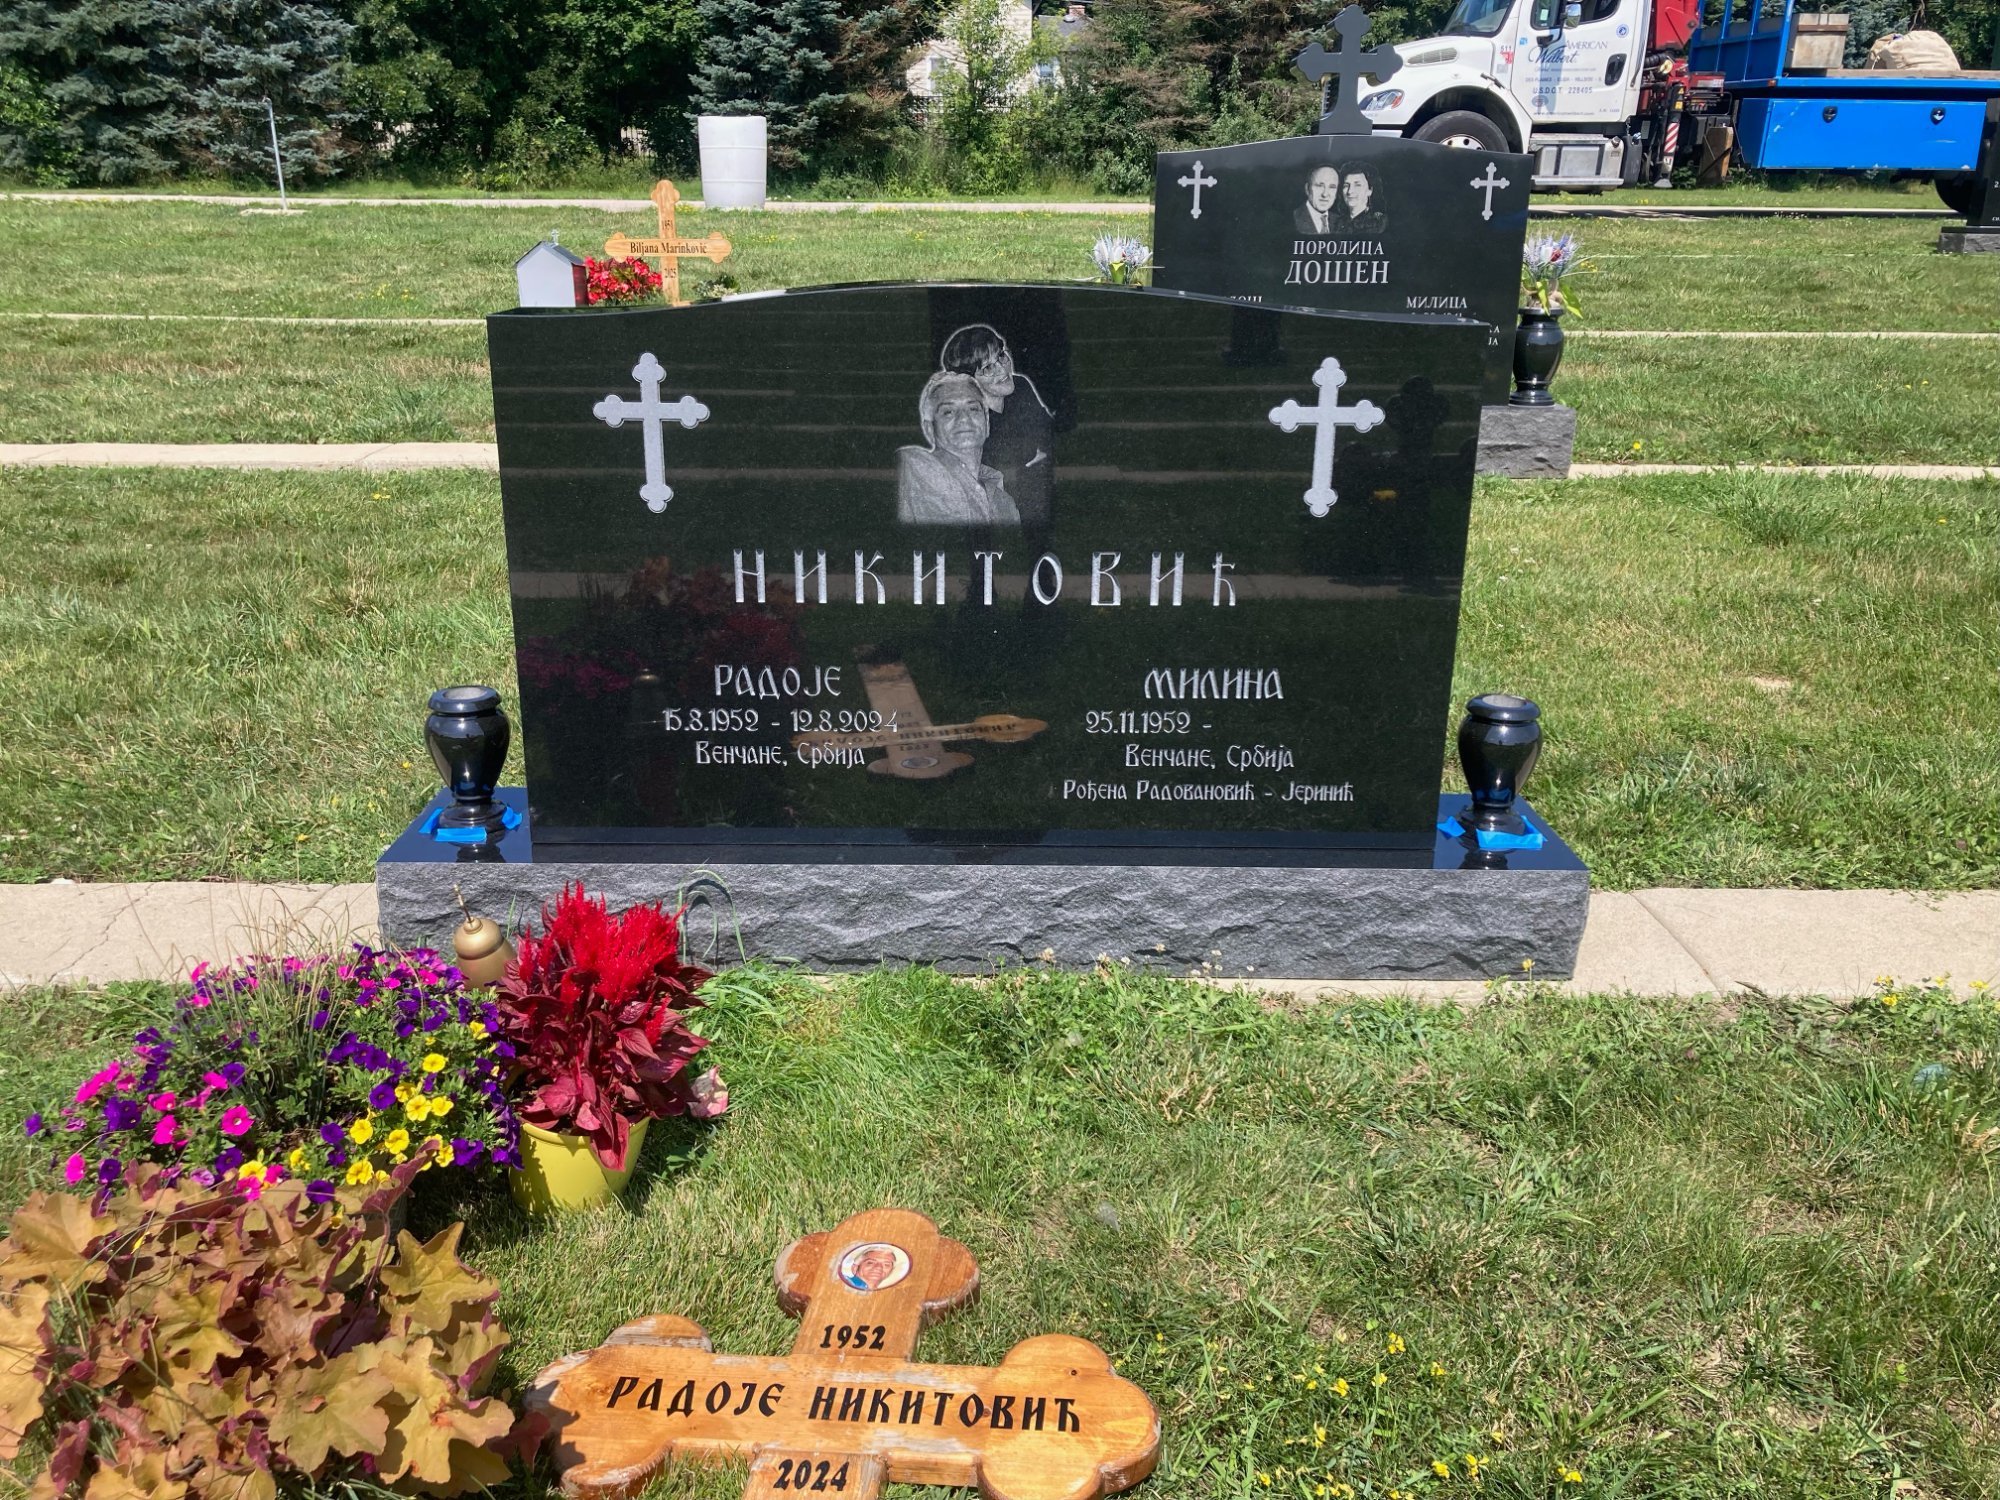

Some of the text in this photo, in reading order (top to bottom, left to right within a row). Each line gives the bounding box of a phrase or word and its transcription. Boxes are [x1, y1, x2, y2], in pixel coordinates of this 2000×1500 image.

[630, 242, 707, 255] Biljana Marinković
[1293, 240, 1384, 256] ПОРОДИЦА
[1284, 260, 1390, 285] ДОШЕН
[1406, 296, 1468, 309] МИЛИЦА
[733, 549, 1236, 607] НИКИТОВИЋ
[714, 664, 842, 700] РАДОЈЕ
[1144, 668, 1284, 700] МИЛИНА
[662, 708, 759, 732] 15.8.1952
[791, 708, 898, 733] 12.8.2024
[1085, 710, 1191, 734] 25.11.1952
[696, 740, 865, 768] Венчане, Србија
[1125, 743, 1294, 772] Венчане, Србија
[1063, 779, 1127, 802] Рођена
[1136, 779, 1255, 801] Радовановић
[1281, 780, 1354, 804] Јеринић
[819, 1325, 886, 1350] 1952
[606, 1376, 1081, 1433] РАДОЈЕ НИКИТОВИЋ
[772, 1458, 849, 1492] 2024
